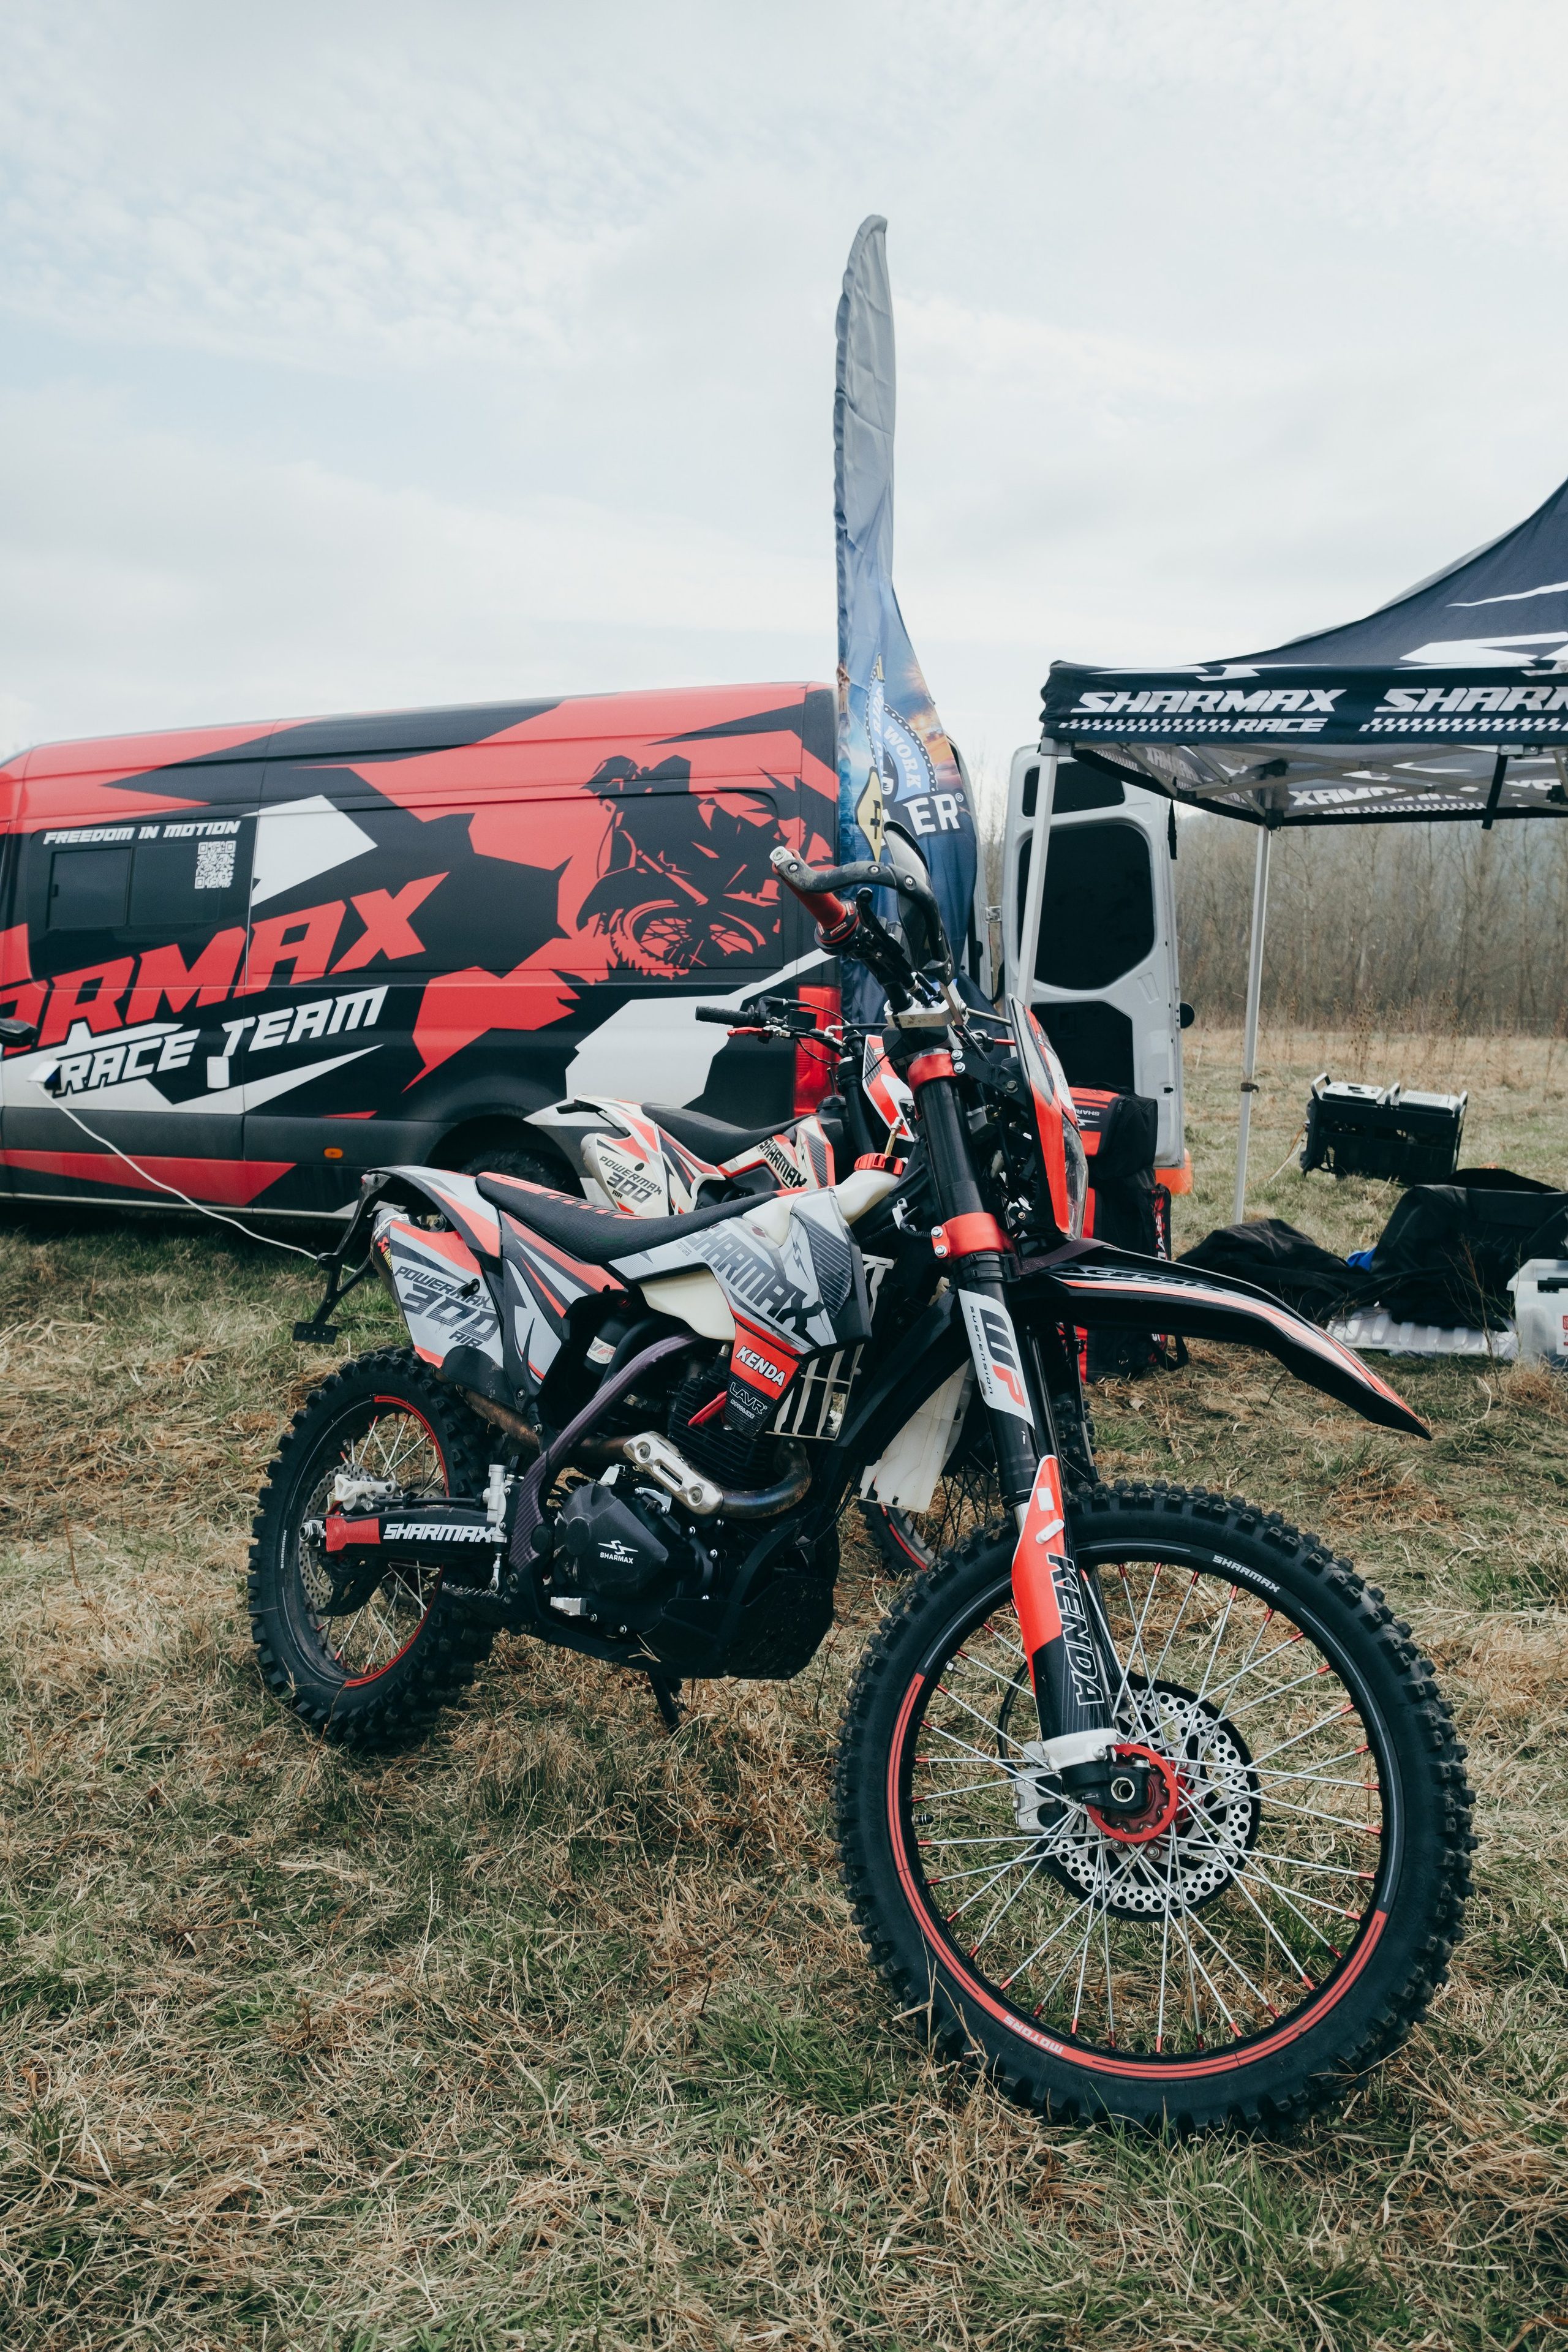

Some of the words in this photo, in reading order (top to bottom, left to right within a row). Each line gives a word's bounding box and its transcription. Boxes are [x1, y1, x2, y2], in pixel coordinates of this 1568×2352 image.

[1070, 688, 1348, 713] SHARMAX
[1231, 718, 1329, 732] RACE
[884, 725, 921, 788] WORK
[43, 827, 135, 844] FREEDOM
[138, 826, 159, 839] IN
[163, 821, 241, 837] MOTION
[60, 1030, 200, 1094] RACE
[222, 986, 388, 1057] TEAM
[1074, 1109, 1100, 1117] SHAR
[599, 1156, 662, 1195] POWERMAX
[606, 1172, 653, 1203] 300
[612, 1189, 623, 1199] AIR
[684, 1223, 826, 1348] SHARMAX
[401, 1283, 500, 1342] 300
[448, 1330, 484, 1348] AIR
[970, 1305, 993, 1395] SUSPENSION
[736, 1346, 786, 1386] KENDA
[383, 1523, 497, 1543] SHARMAX
[600, 1551, 634, 1564] SHARMAX
[1212, 1555, 1280, 1593] SHARMAX
[1046, 1552, 1105, 1706] KENDA
[1003, 2015, 1064, 2054] MOTORS
